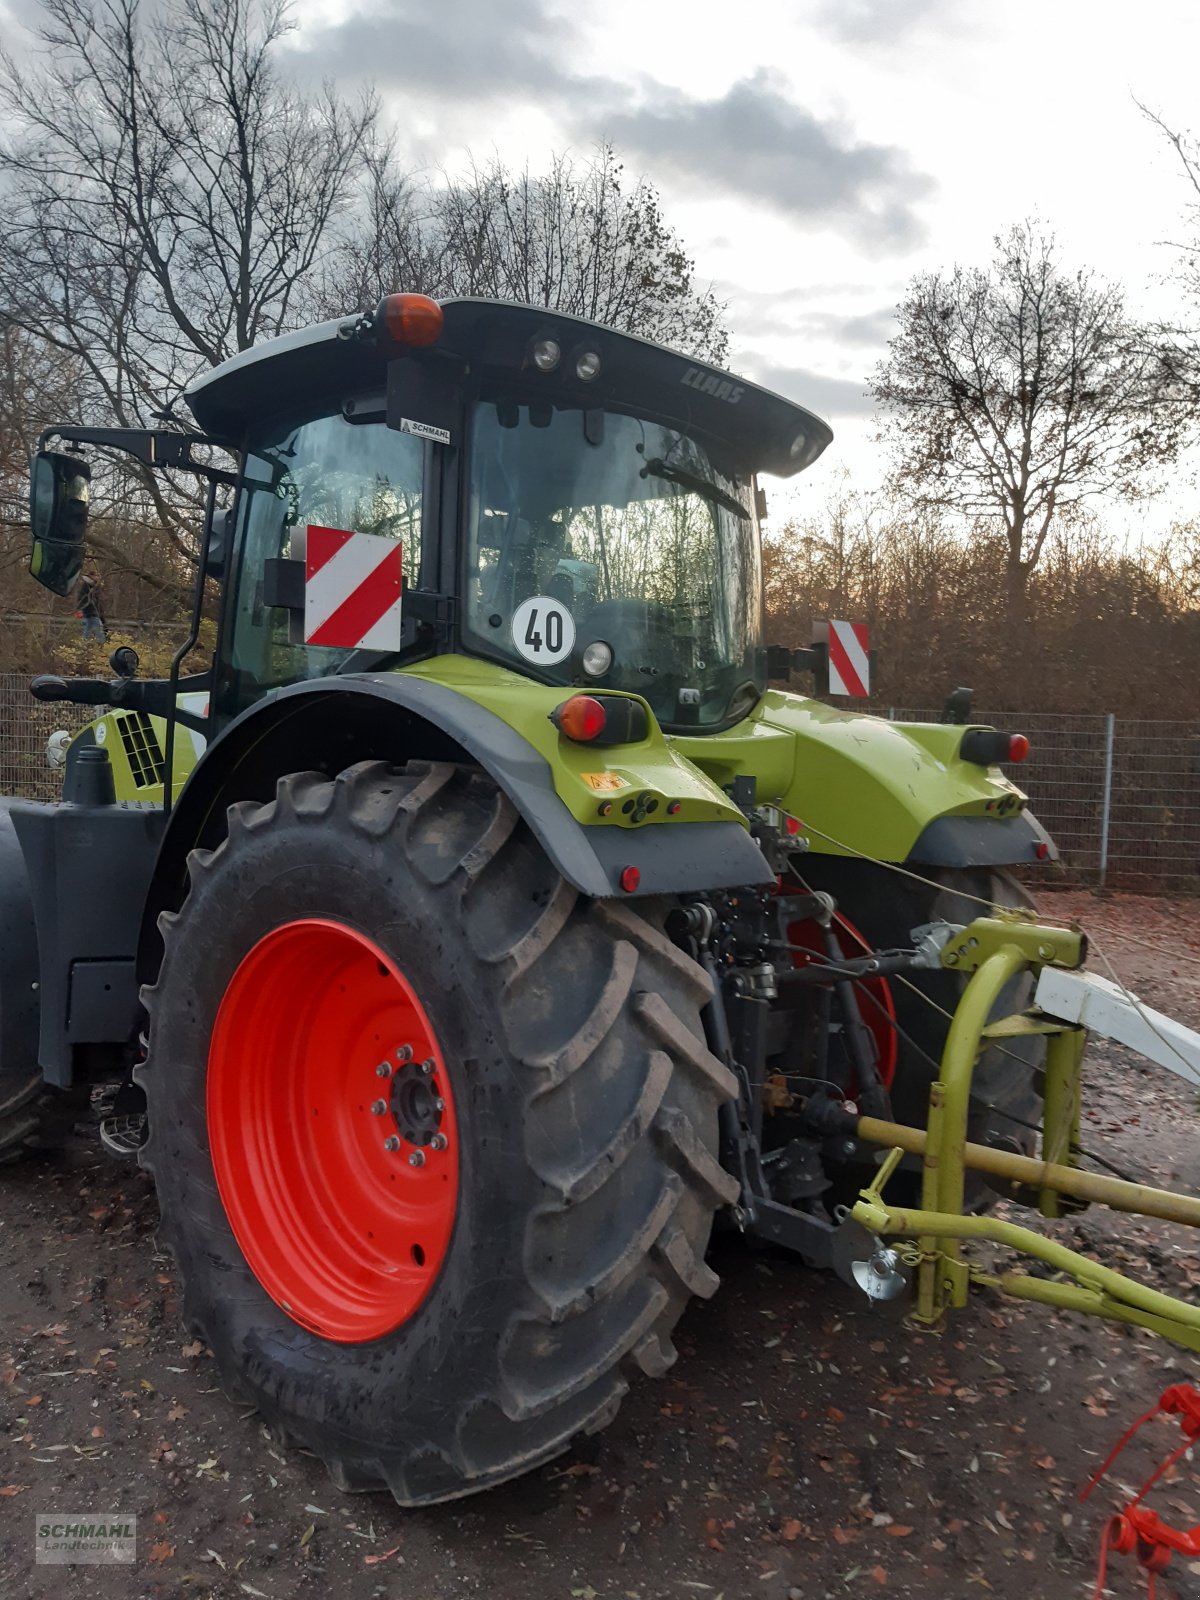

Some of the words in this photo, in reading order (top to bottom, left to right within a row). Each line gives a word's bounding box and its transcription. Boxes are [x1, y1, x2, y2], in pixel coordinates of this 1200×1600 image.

[680, 367, 745, 404] CLAAS
[412, 422, 449, 439] SCHMAHL
[525, 609, 563, 653] 40
